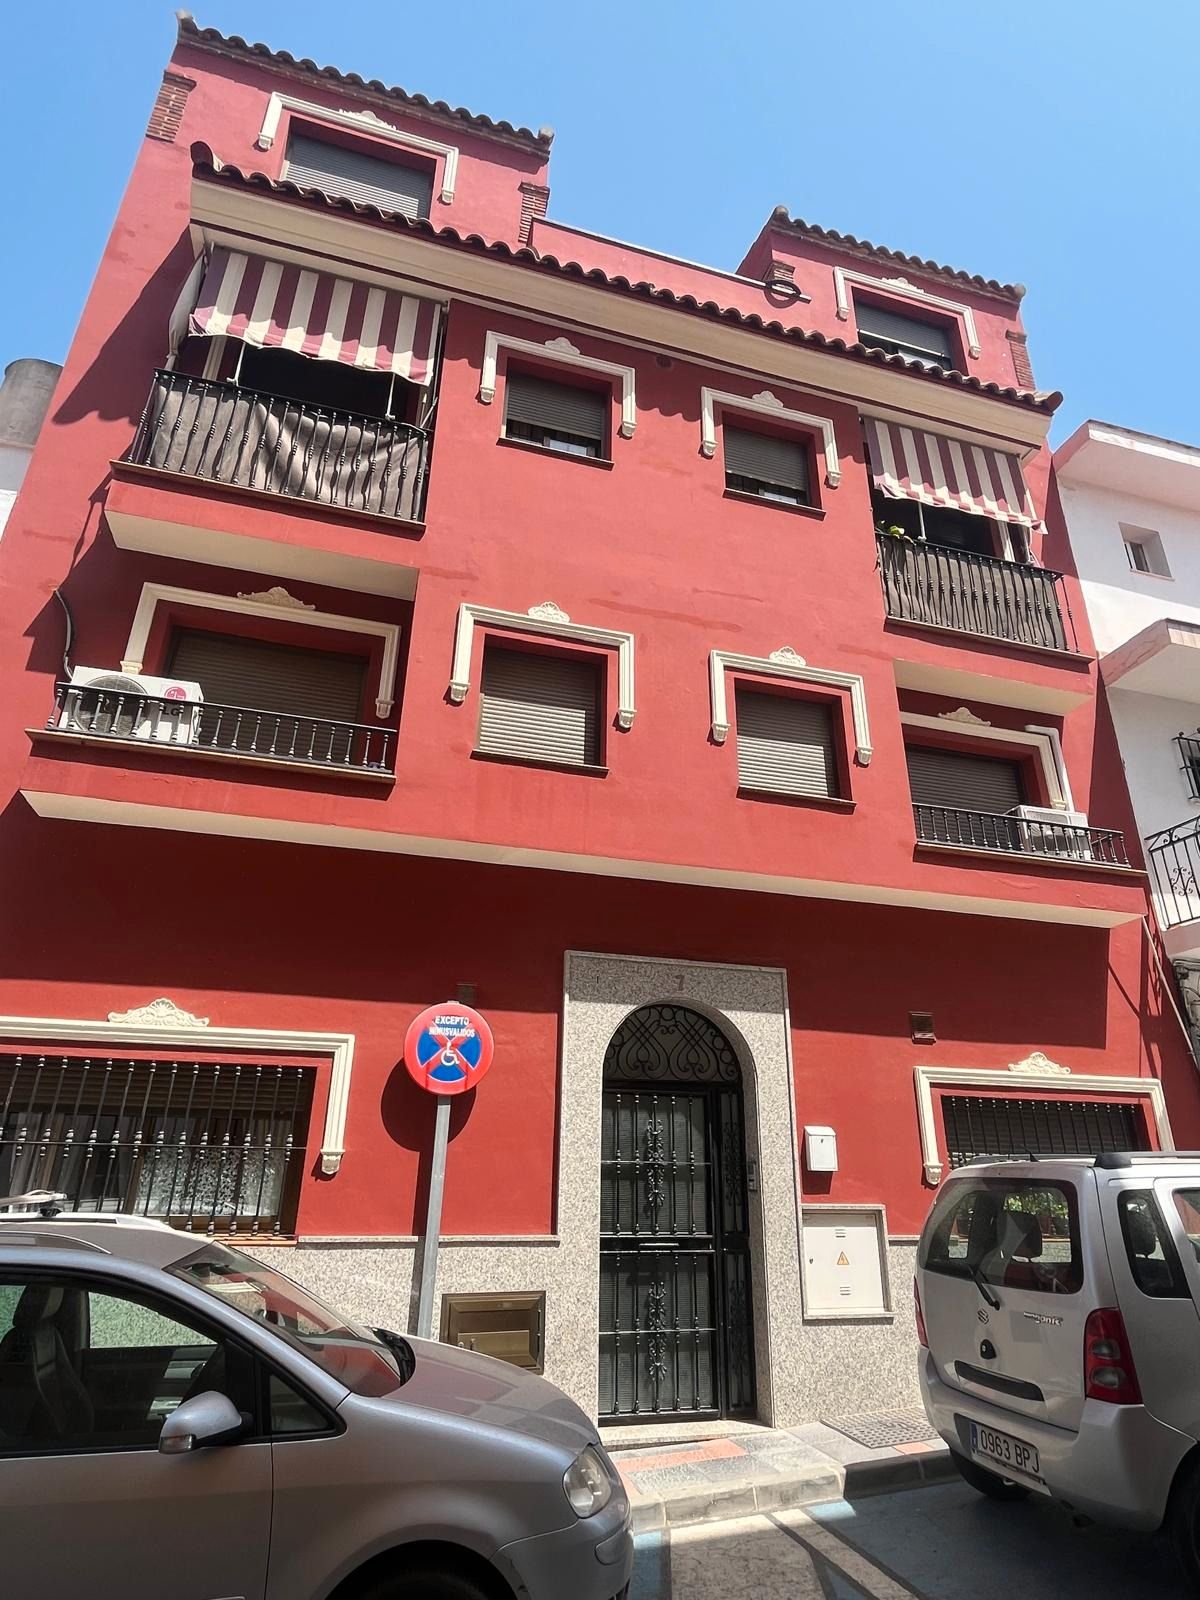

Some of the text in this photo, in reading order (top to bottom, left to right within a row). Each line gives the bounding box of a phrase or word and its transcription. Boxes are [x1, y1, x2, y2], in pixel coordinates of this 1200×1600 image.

[161, 705, 180, 716] LG
[434, 1015, 470, 1025] EXCEPTO
[980, 1429, 1011, 1460] 0963
[1014, 1443, 1040, 1473] BPJ
